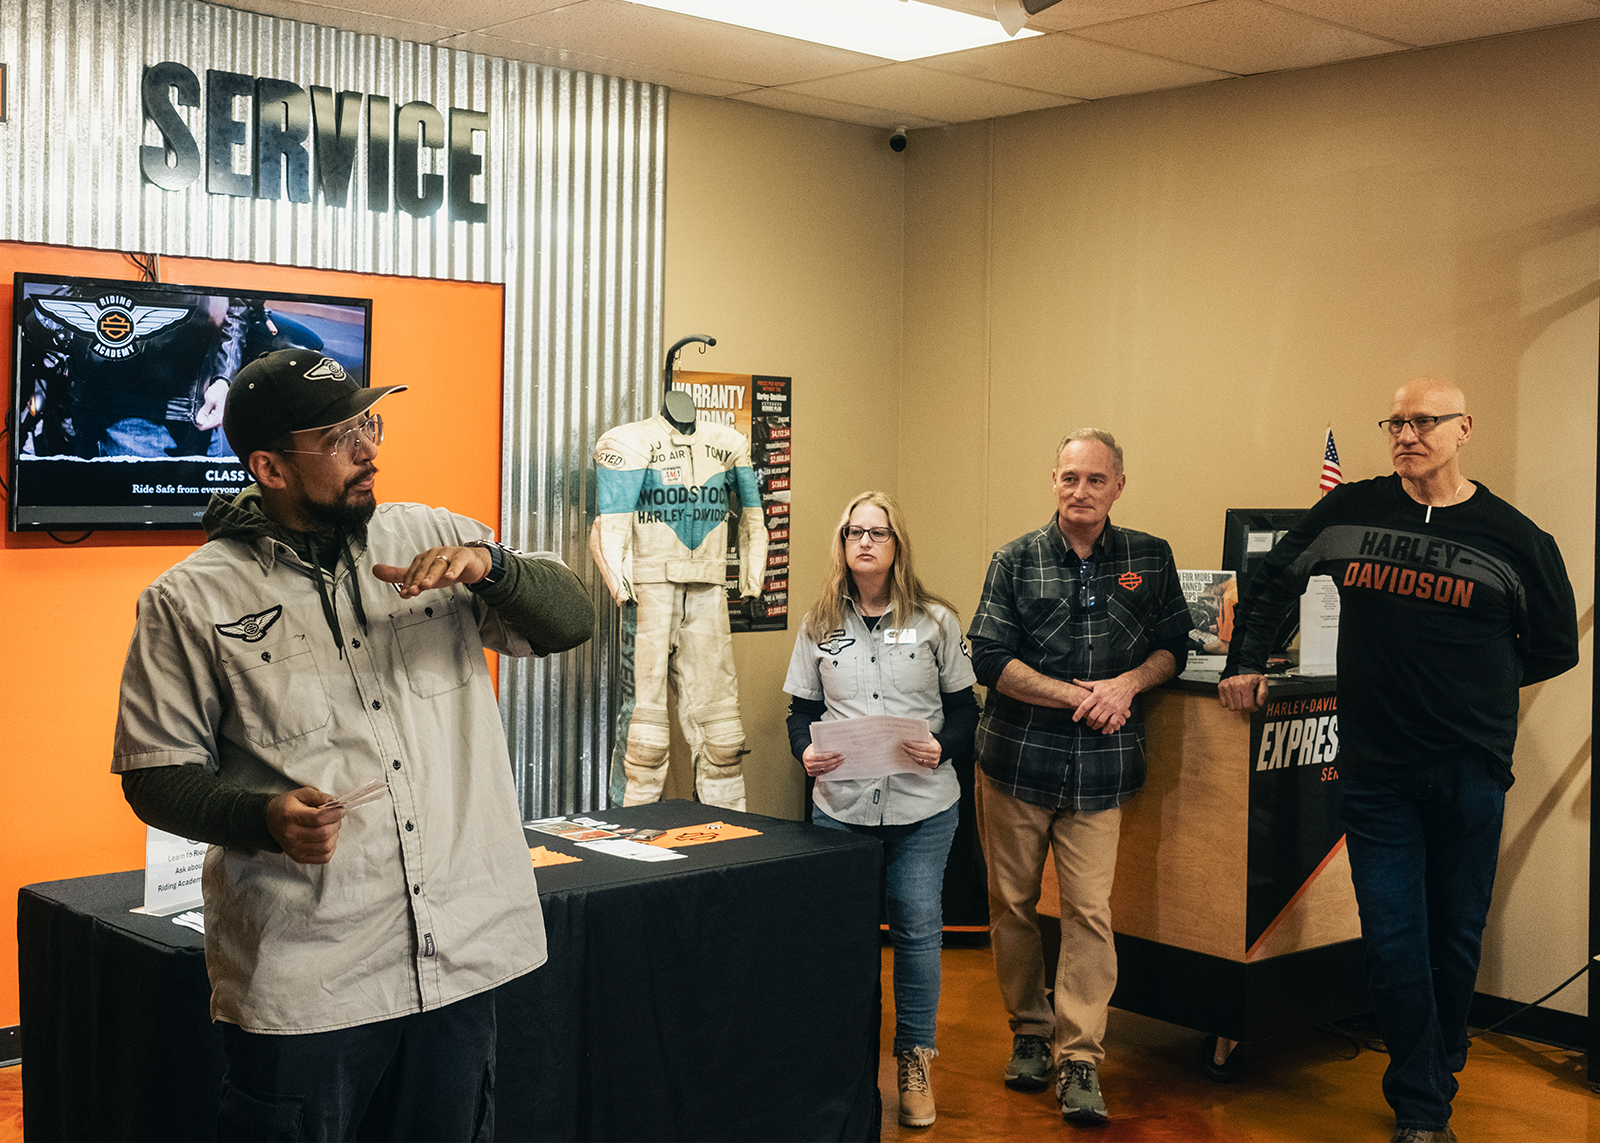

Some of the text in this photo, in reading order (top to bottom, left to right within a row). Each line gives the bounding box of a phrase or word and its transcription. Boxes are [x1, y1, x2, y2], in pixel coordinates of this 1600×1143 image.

[139, 61, 489, 223] SERVICE
[99, 295, 133, 308] RIDING
[93, 344, 135, 358] ACADEMY
[599, 452, 623, 465] SYED
[669, 449, 685, 460] AIR
[705, 444, 732, 463] TONY
[205, 470, 245, 481] CLASS
[132, 484, 154, 494] Ride
[156, 484, 175, 494] Safe
[177, 485, 199, 494] from
[201, 487, 240, 495] everyone
[639, 485, 729, 506] WOODSTOC
[638, 508, 728, 524] HARLEY-DAVIDS
[1359, 531, 1472, 569] HARLEY-
[1182, 572, 1193, 581] FOR
[1194, 572, 1212, 582] MORE
[1343, 562, 1474, 608] DAVIDSON
[1256, 714, 1339, 772] EXPRES
[168, 853, 186, 862] Learn
[175, 866, 186, 875] Ask
[158, 882, 177, 892] Riding
